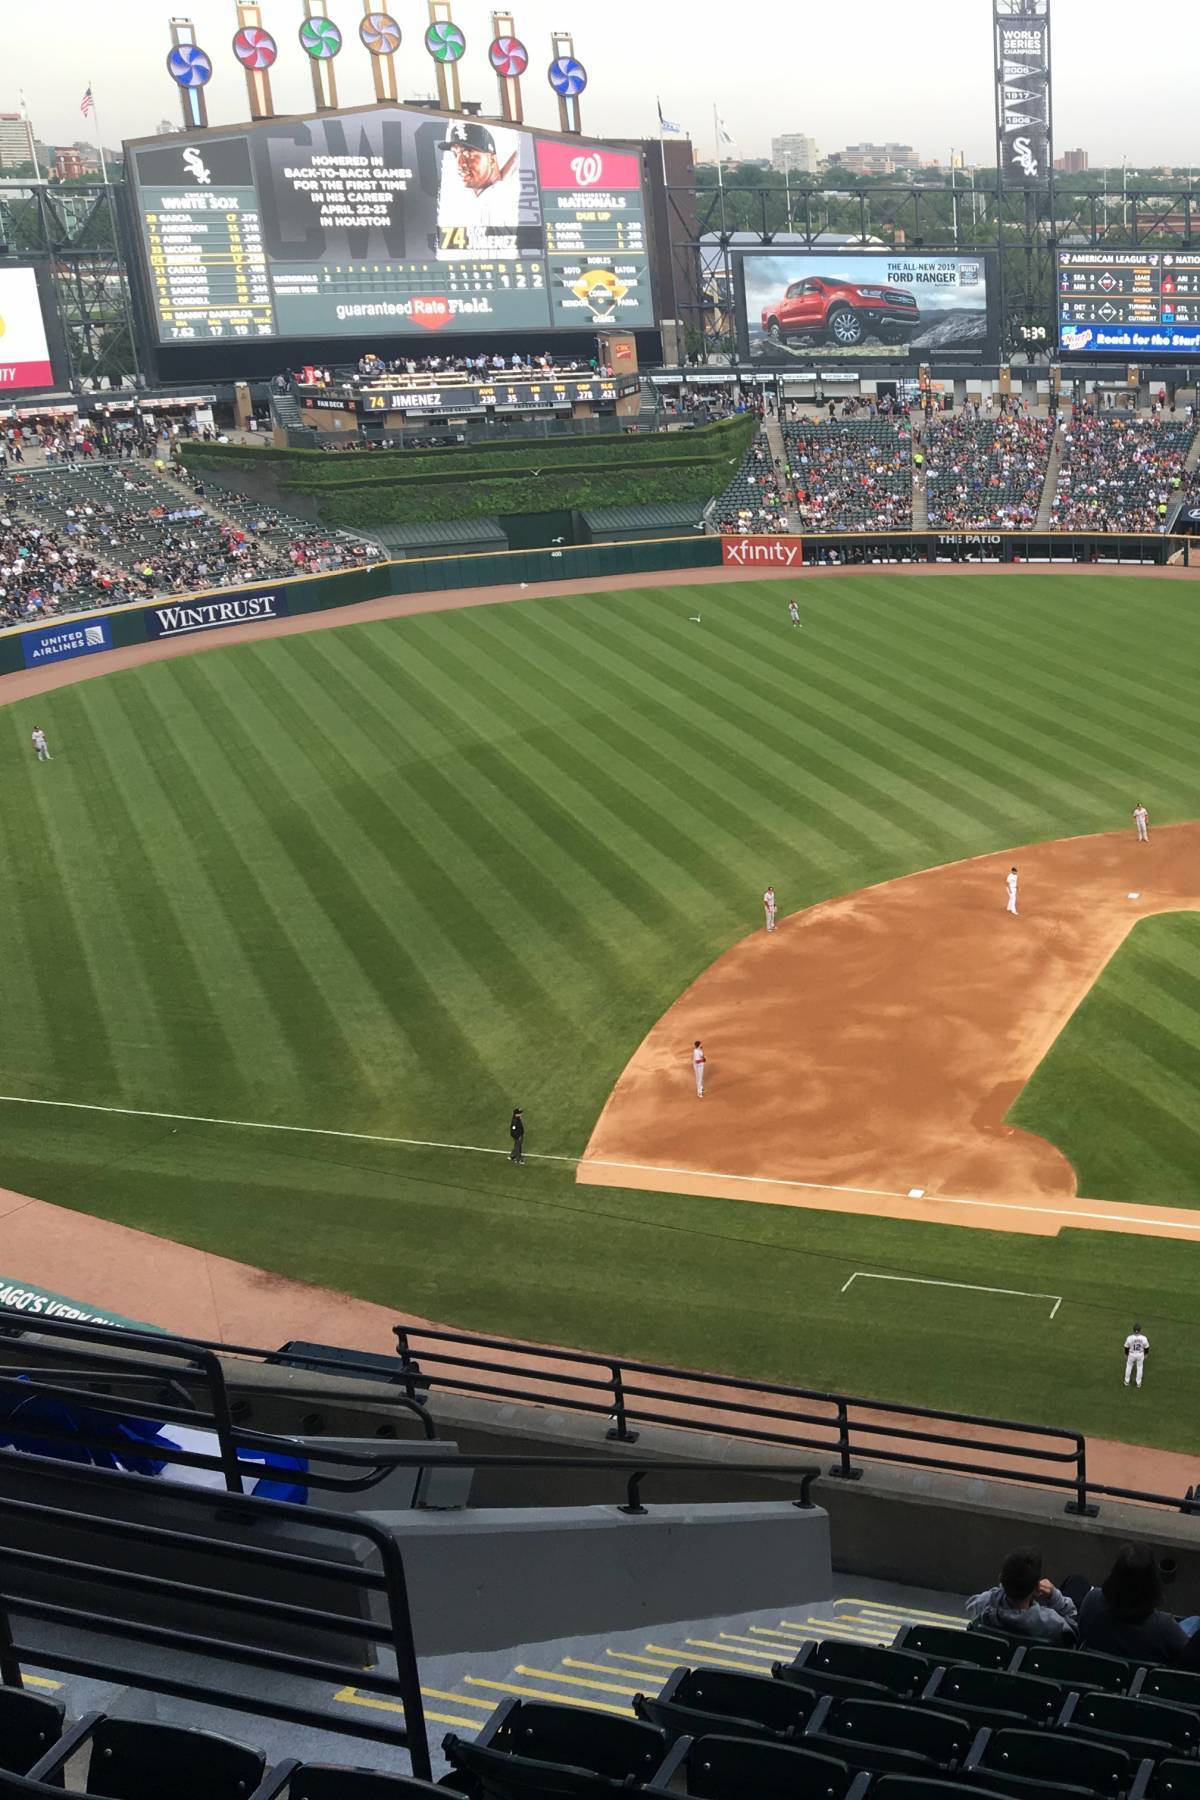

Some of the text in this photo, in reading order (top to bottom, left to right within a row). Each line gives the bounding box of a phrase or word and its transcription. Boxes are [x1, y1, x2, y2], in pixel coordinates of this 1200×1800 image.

[1003, 31, 1041, 39] WORLD
[1004, 40, 1041, 49] SERIES
[312, 156, 383, 167] HOMERED IN
[284, 168, 412, 178] BACK-TO-BACK GAMES
[294, 180, 406, 190] FOR THE FIRST TIME
[311, 192, 393, 202] IN HIS CAREER
[161, 198, 239, 209] WHITE SOX
[557, 197, 626, 208] NATIONALS
[320, 204, 387, 214] APRIL 22-23
[320, 216, 390, 226] IN HOUSTON
[441, 227, 465, 249] 74
[1071, 255, 1114, 263] AMERICAN
[888, 263, 956, 271] THE ALL-NEW 2019
[501, 275, 543, 287] 1 2 2
[888, 273, 956, 283] FORD RANGER
[336, 297, 493, 320] guaranteed Rate Field.
[1020, 326, 1046, 340] 7:39
[1097, 334, 1131, 345] Reach
[1133, 333, 1150, 345] for
[1151, 334, 1170, 345] the
[317, 400, 329, 408] FAN
[369, 394, 442, 408] 74 JIMENEZ
[938, 535, 1001, 544] THE PATIO
[727, 540, 798, 565] xfinity
[41, 631, 83, 647] UNITED
[33, 640, 85, 658] AIRLINES
